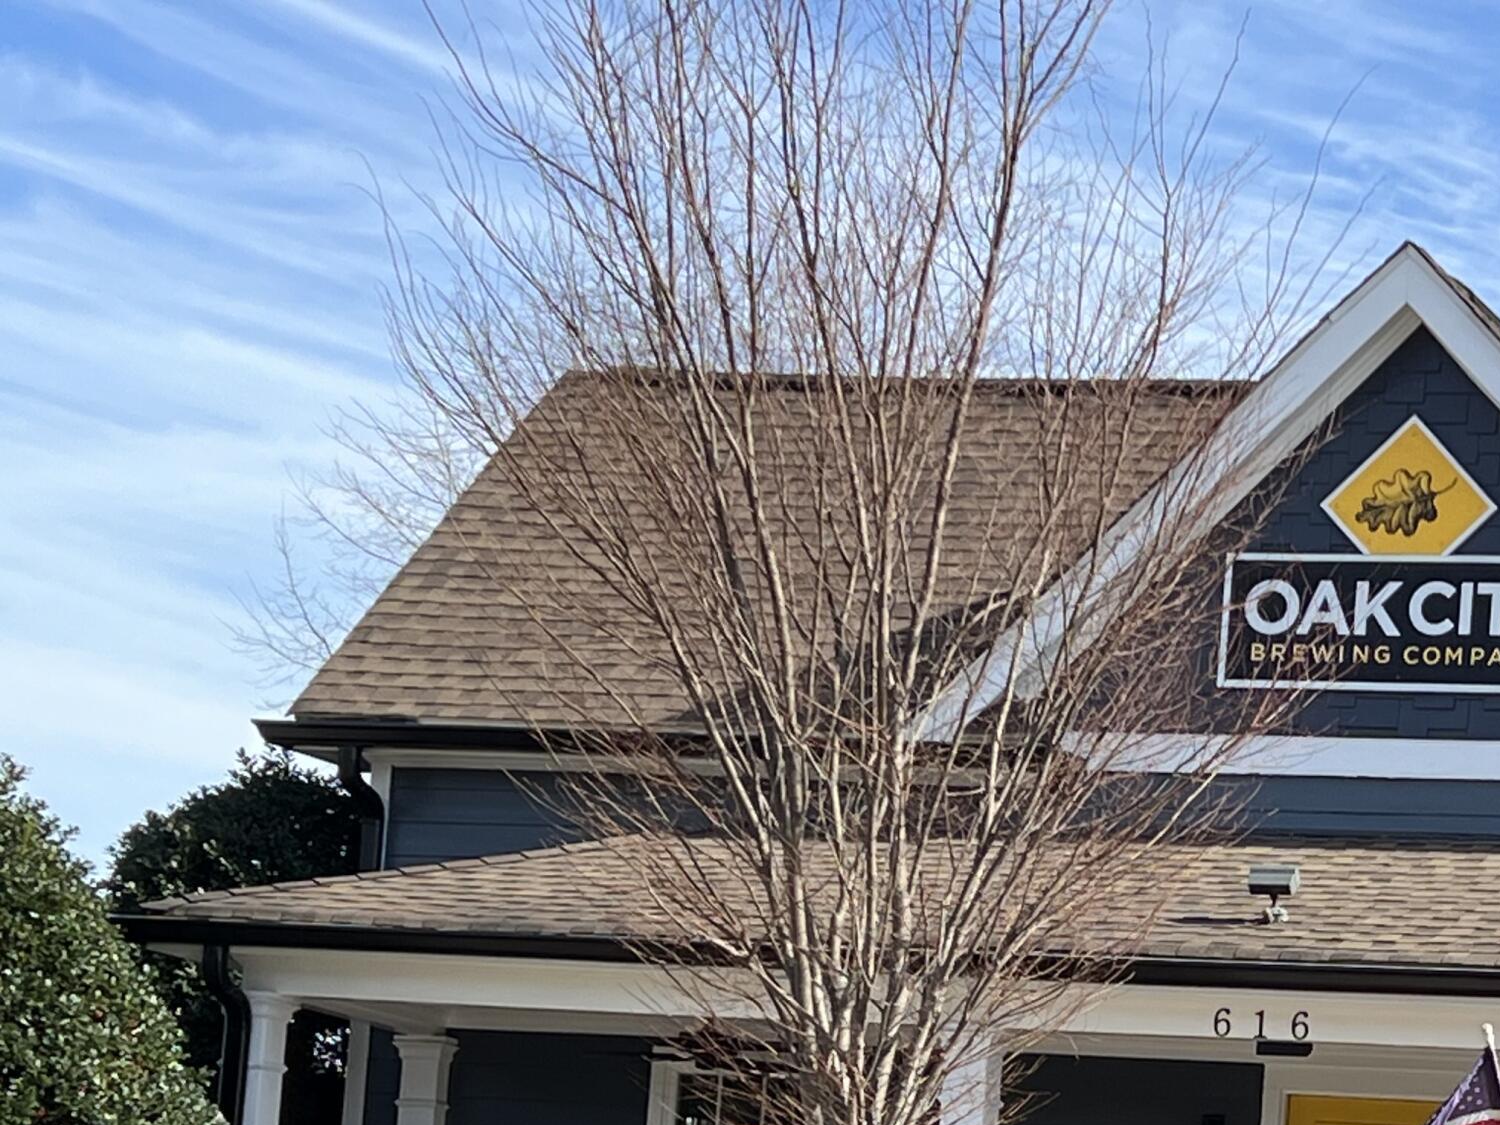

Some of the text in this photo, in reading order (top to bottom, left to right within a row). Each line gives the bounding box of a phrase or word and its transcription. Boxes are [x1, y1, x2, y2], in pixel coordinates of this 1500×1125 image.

[1244, 579, 1403, 637] OAK
[1250, 643, 1391, 664] BREWING
[1213, 1007, 1309, 1040] 616
